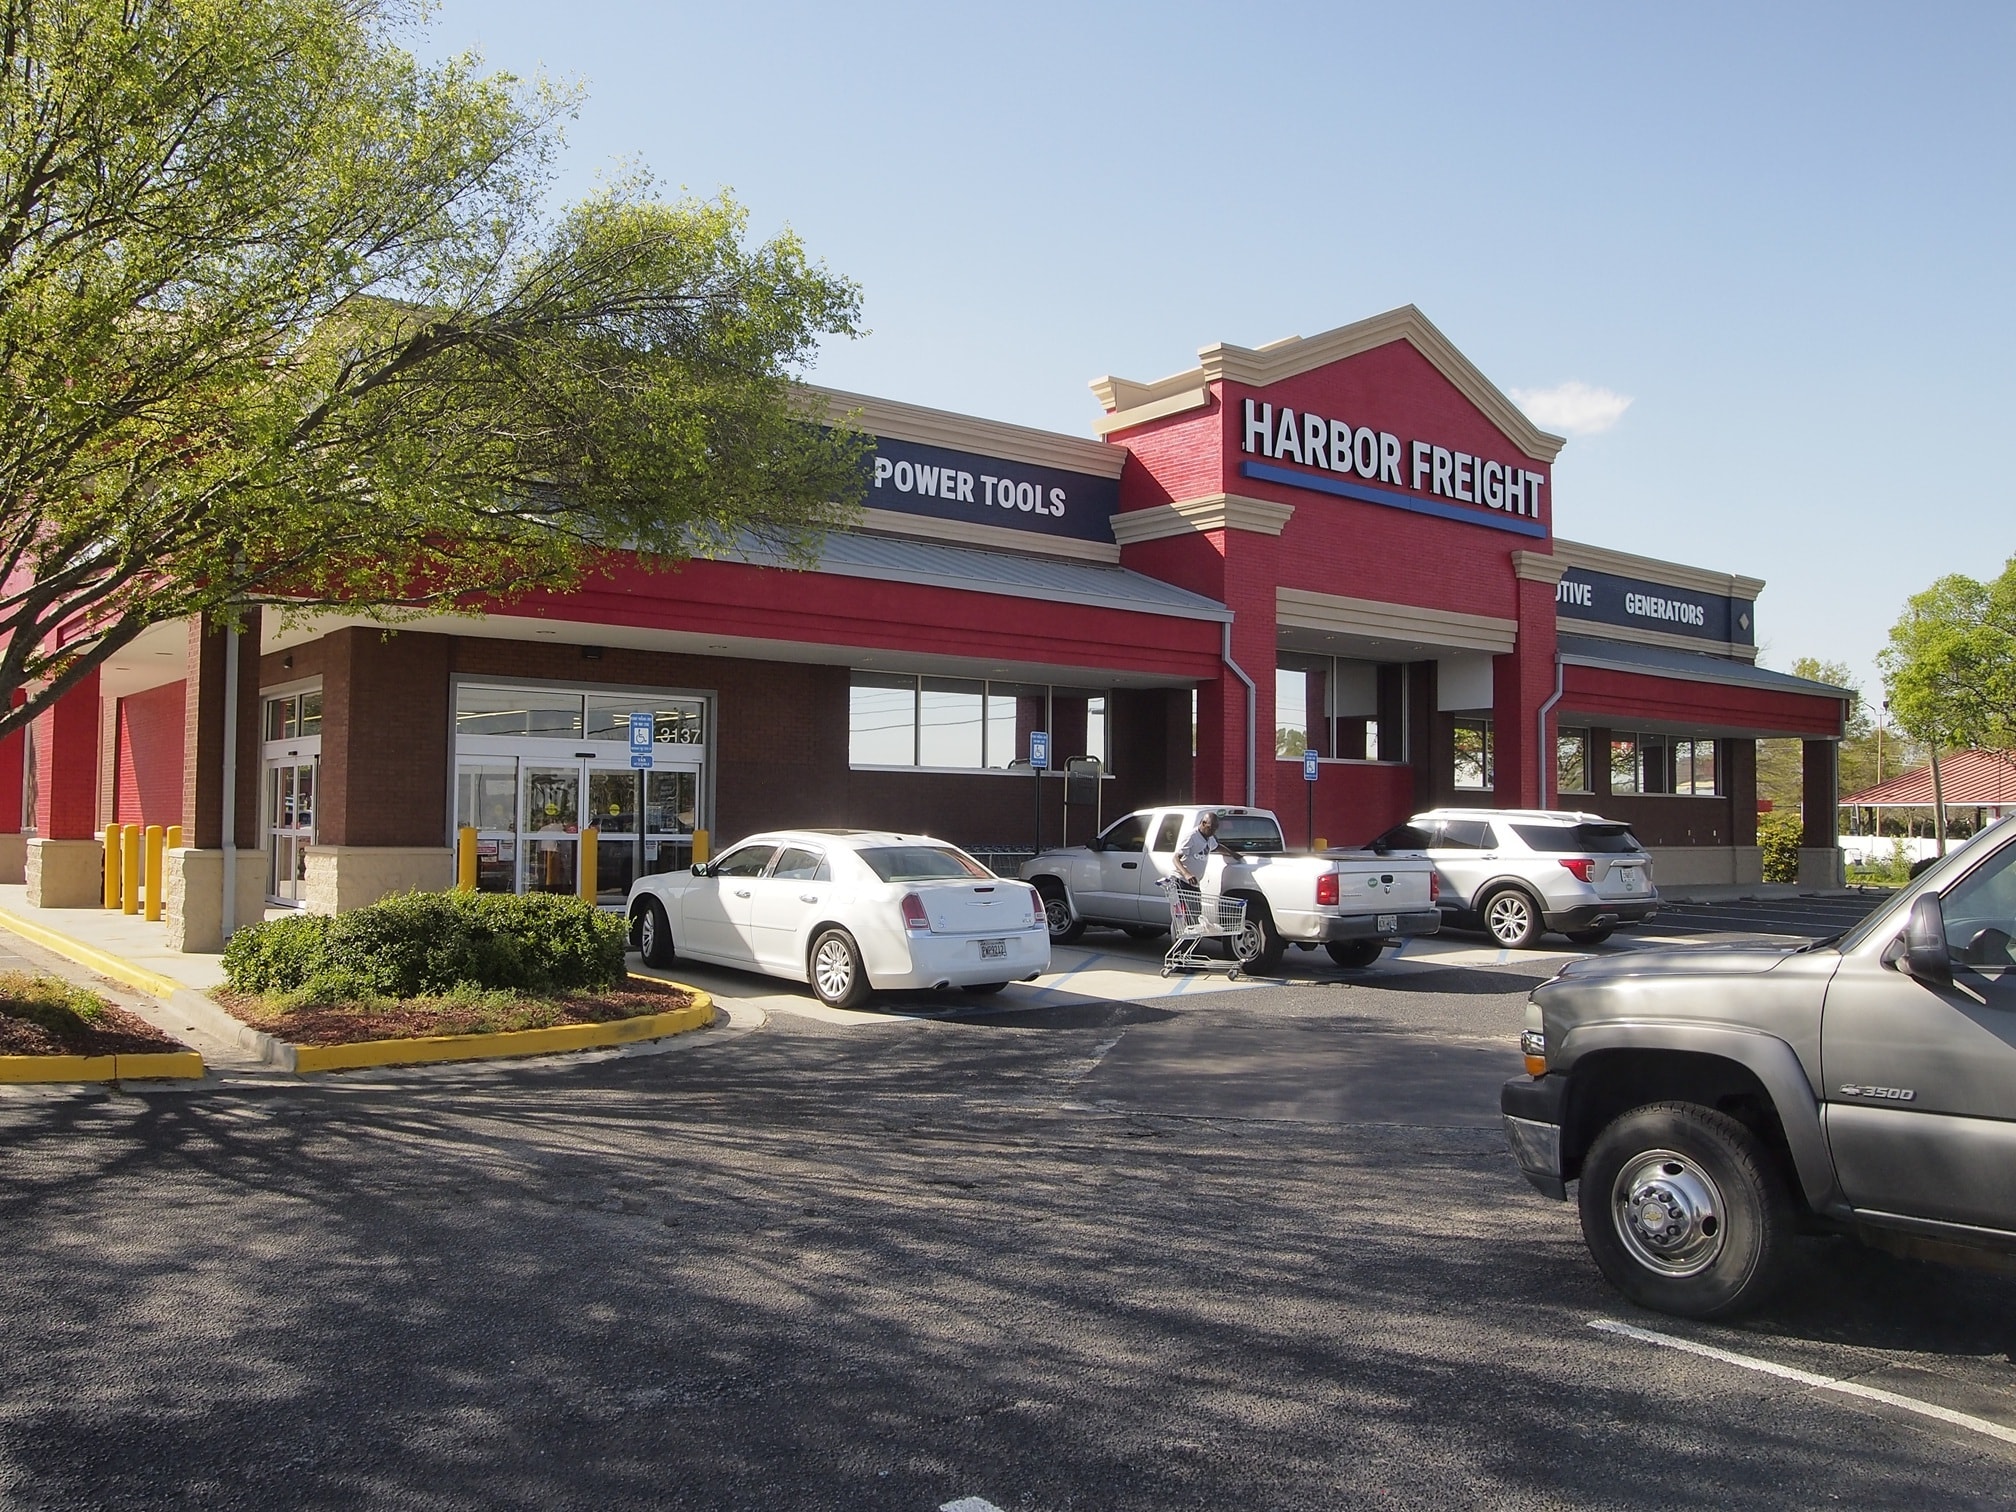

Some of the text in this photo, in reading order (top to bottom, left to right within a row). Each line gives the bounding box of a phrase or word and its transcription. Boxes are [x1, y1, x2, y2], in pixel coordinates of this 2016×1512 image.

[1243, 398, 1545, 519] HARBOR FREIGHT
[874, 457, 1066, 517] POWER TOOLS
[1625, 592, 1704, 626] GENERATORS
[660, 727, 701, 744] 3137
[1863, 1086, 1915, 1100] 3500
